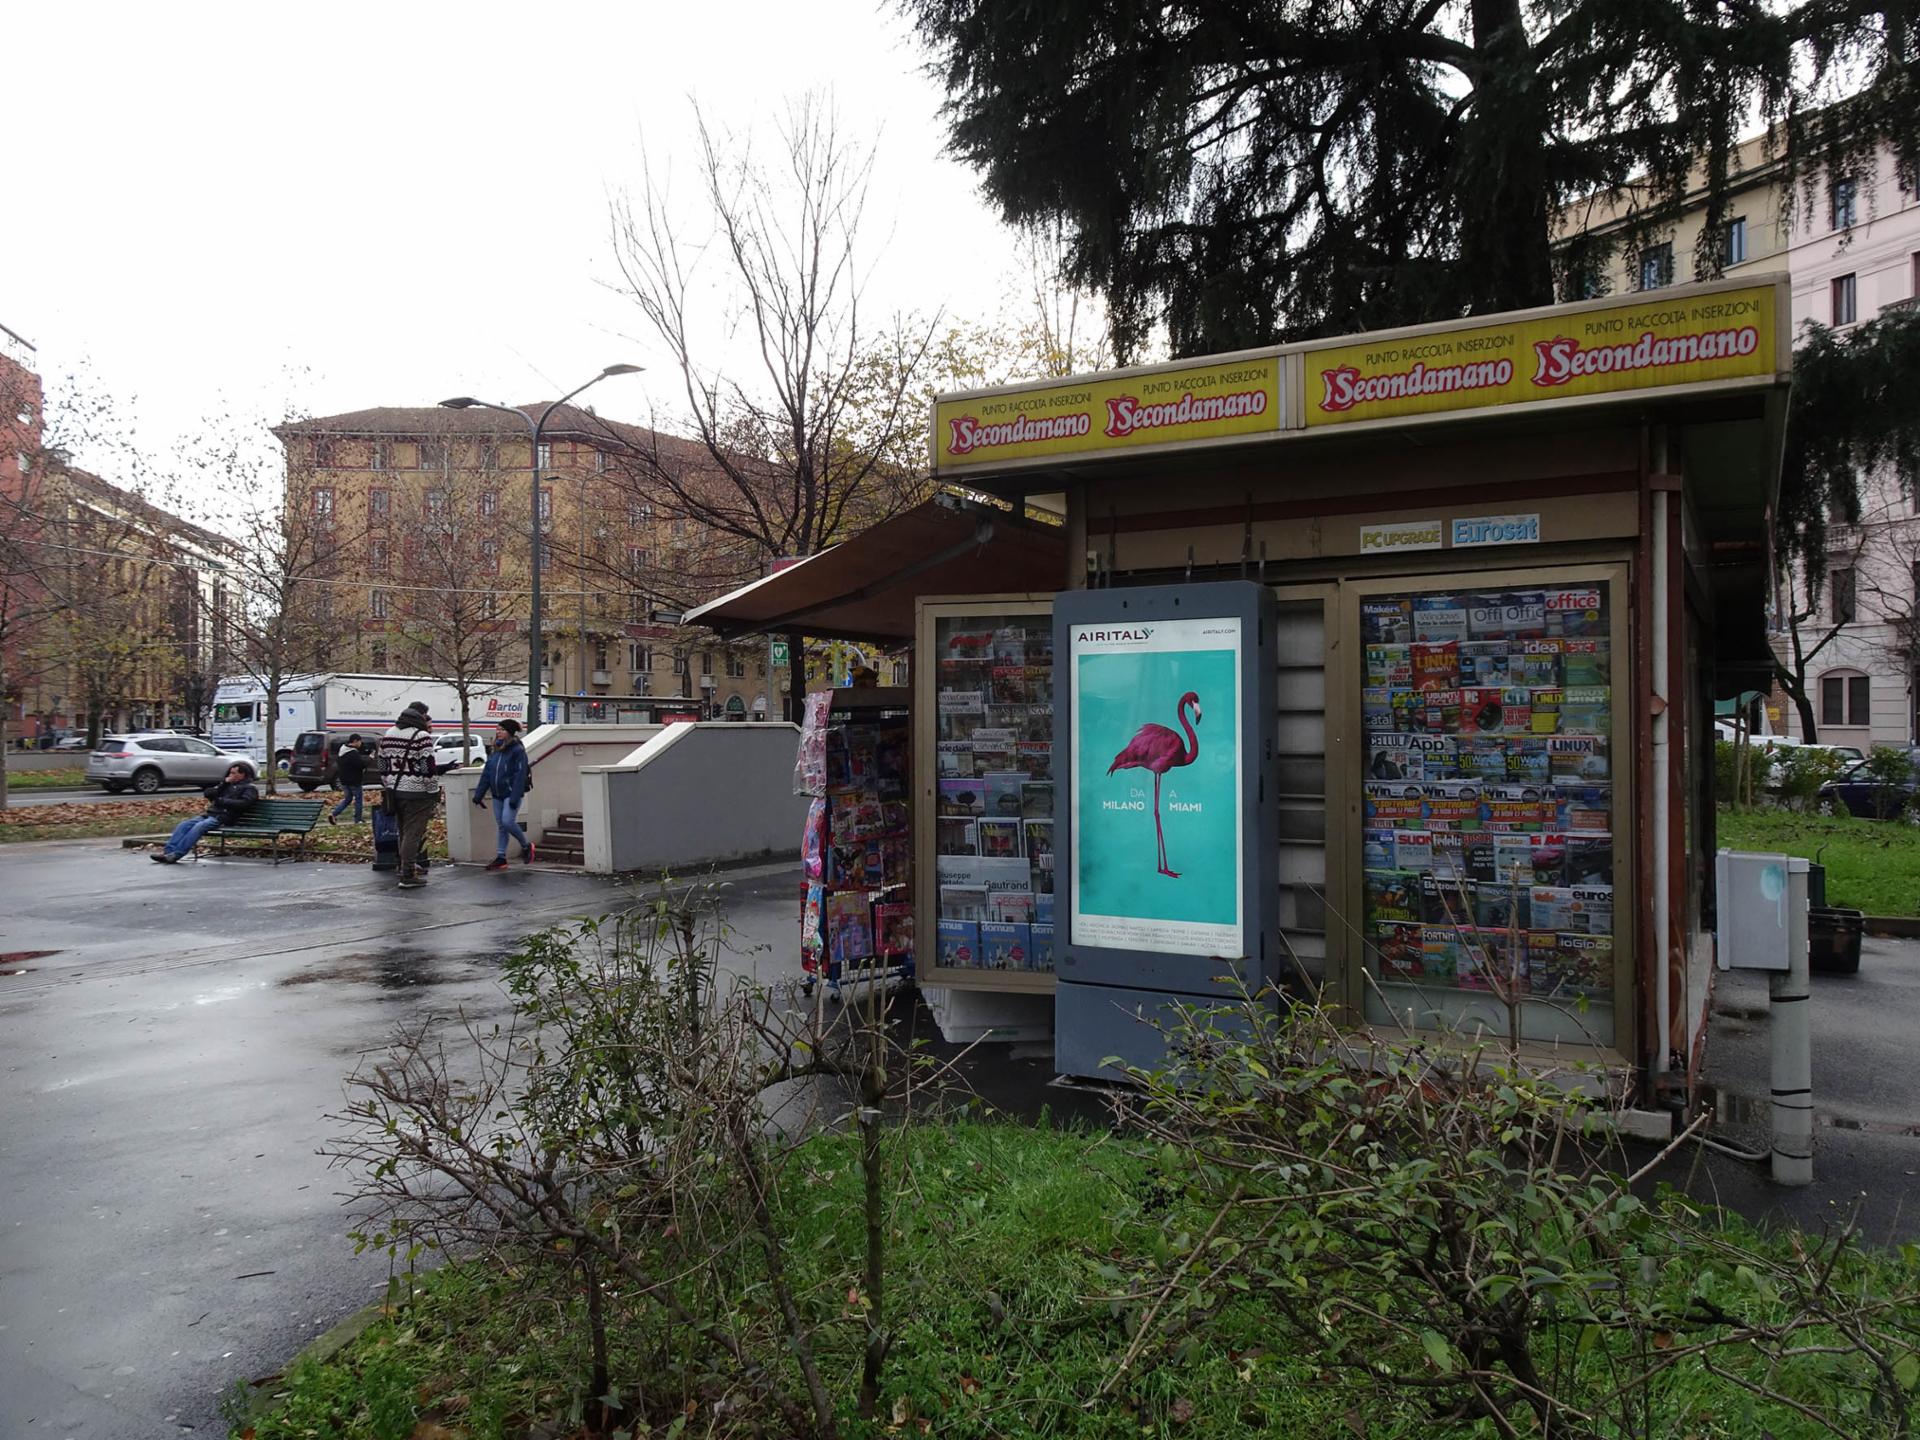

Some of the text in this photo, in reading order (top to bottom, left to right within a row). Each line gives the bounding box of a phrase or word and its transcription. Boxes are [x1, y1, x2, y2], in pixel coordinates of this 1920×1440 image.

[1585, 300, 1758, 335] PUNTO RACCOLTA INSERZIONI
[1365, 335, 1514, 366] PUNTO RACCOLTA INSERZIONI
[1551, 328, 1758, 377] Secondamano
[1144, 369, 1268, 395] PUNTO RACCOLTA INSERZIONI
[1334, 361, 1512, 405] Secondamano
[982, 392, 1092, 416] PUNTO RACCOLTA INSERZIONI
[1117, 391, 1266, 431] Secondamano
[959, 413, 1089, 449] Secondamano
[1362, 529, 1440, 548] PC UPGRADE
[1455, 518, 1538, 544] Eurosat
[1416, 653, 1457, 668] LINUX
[488, 698, 523, 711] Bartoli
[1408, 737, 1445, 752] App
[1552, 740, 1592, 752] LINUX
[1459, 755, 1472, 769] 50
[1508, 755, 1520, 770] 50
[1130, 789, 1145, 798] DA
[1169, 789, 1177, 798] A
[1102, 800, 1145, 811] MILANO
[1169, 802, 1202, 813] MIAMI
[984, 879, 1029, 891] Gautrand
[982, 922, 1016, 934] domus
